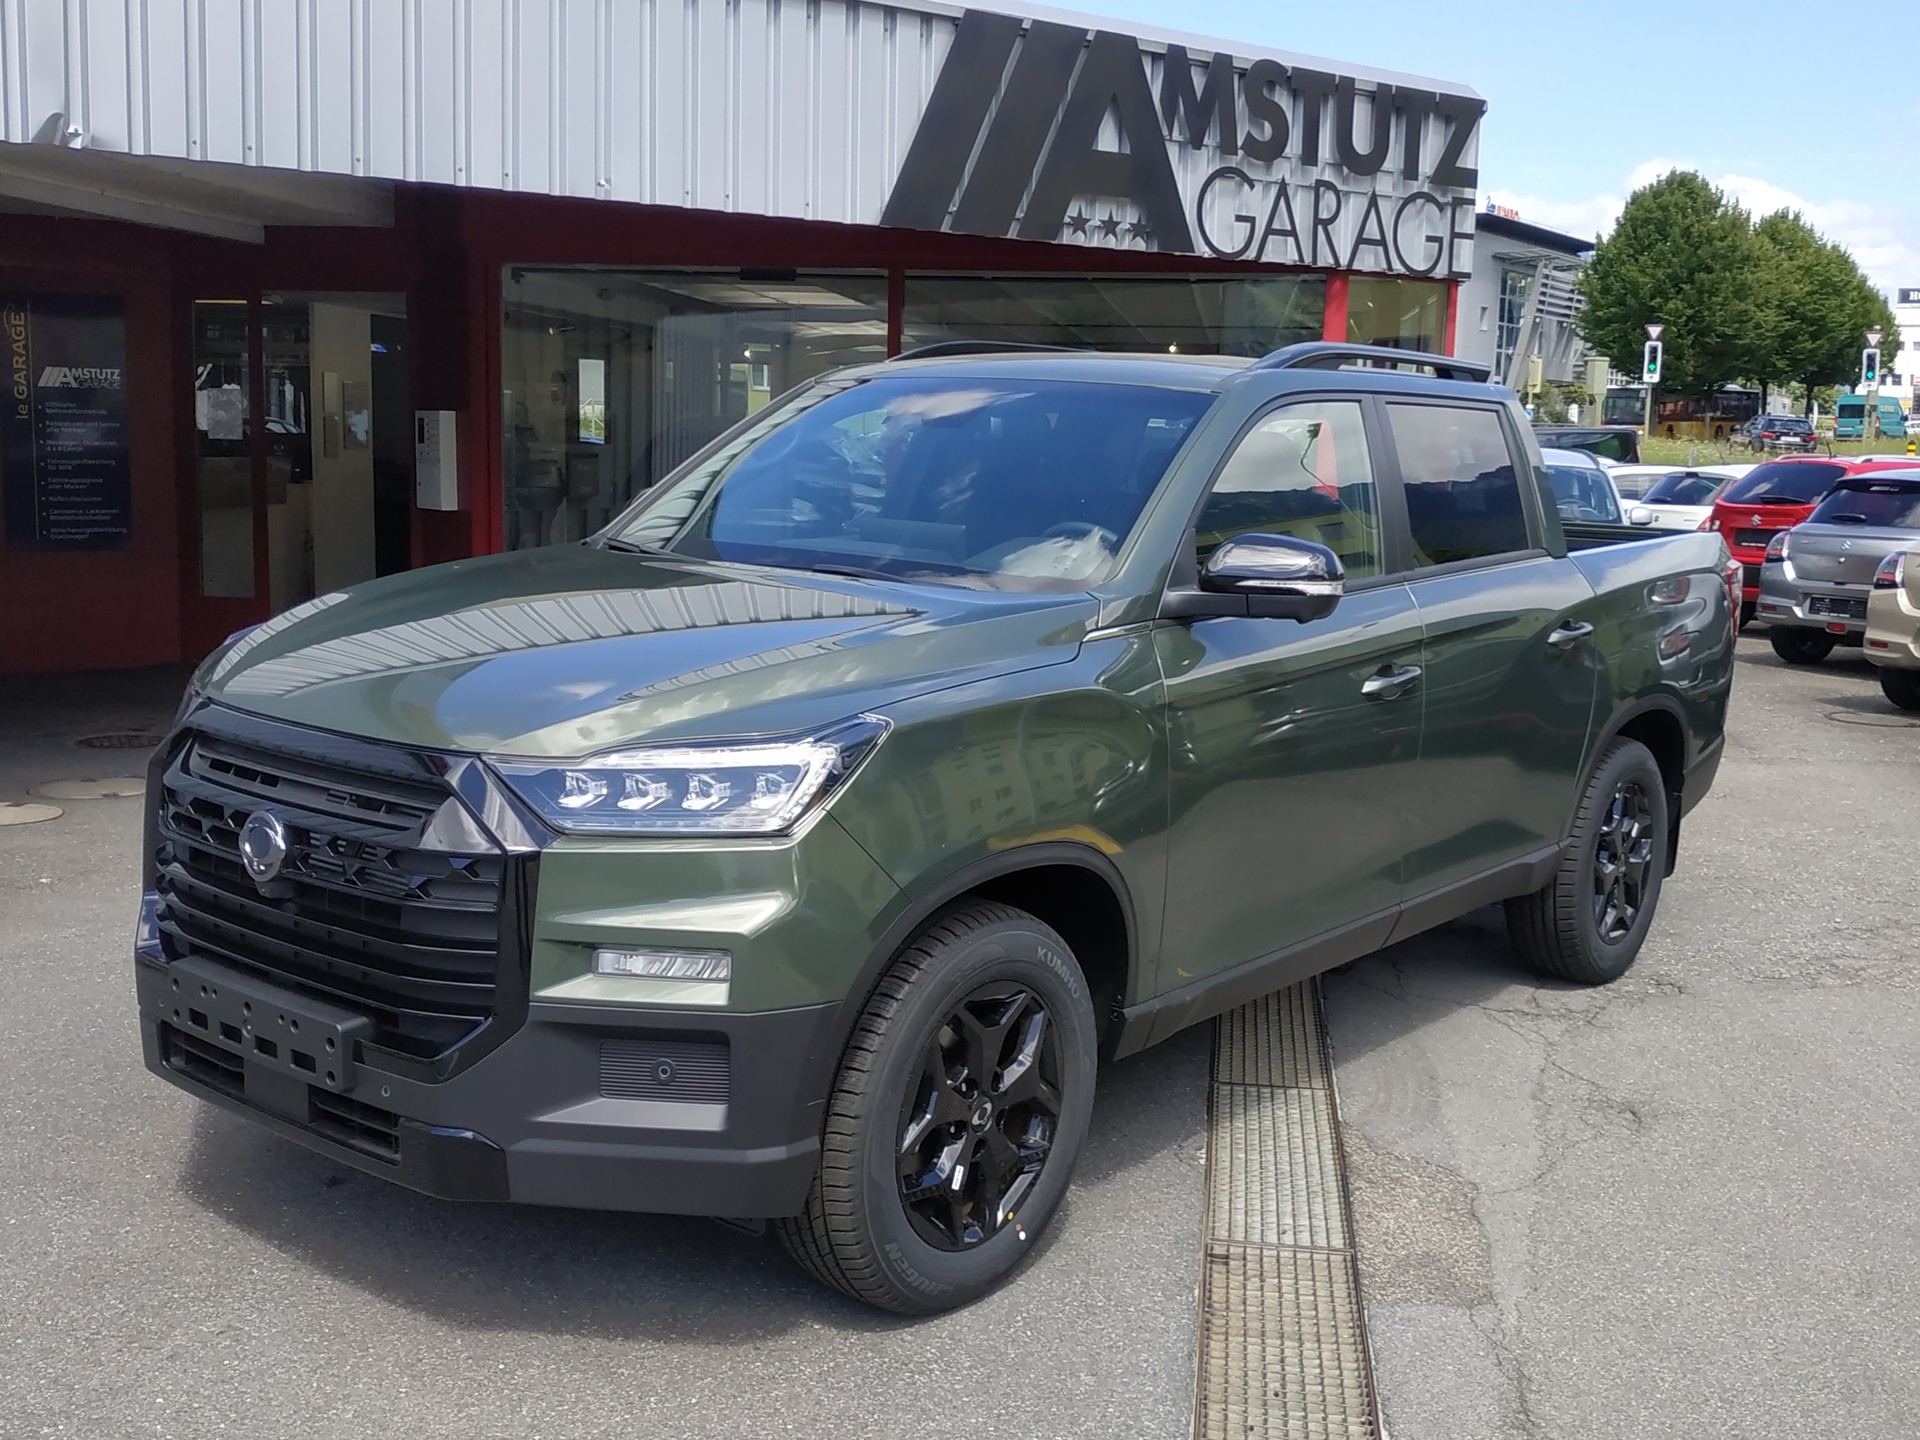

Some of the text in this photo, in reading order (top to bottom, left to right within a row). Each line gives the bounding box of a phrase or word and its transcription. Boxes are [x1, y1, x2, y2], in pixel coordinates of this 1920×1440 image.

[1016, 29, 1488, 254] AMSTUTZ
[1196, 165, 1477, 279] GARAGE
[11, 311, 29, 419] le GARAGE
[54, 366, 121, 388] AMSTUTZ
[76, 378, 121, 389] GARAGE
[1037, 946, 1080, 999] KUMHO
